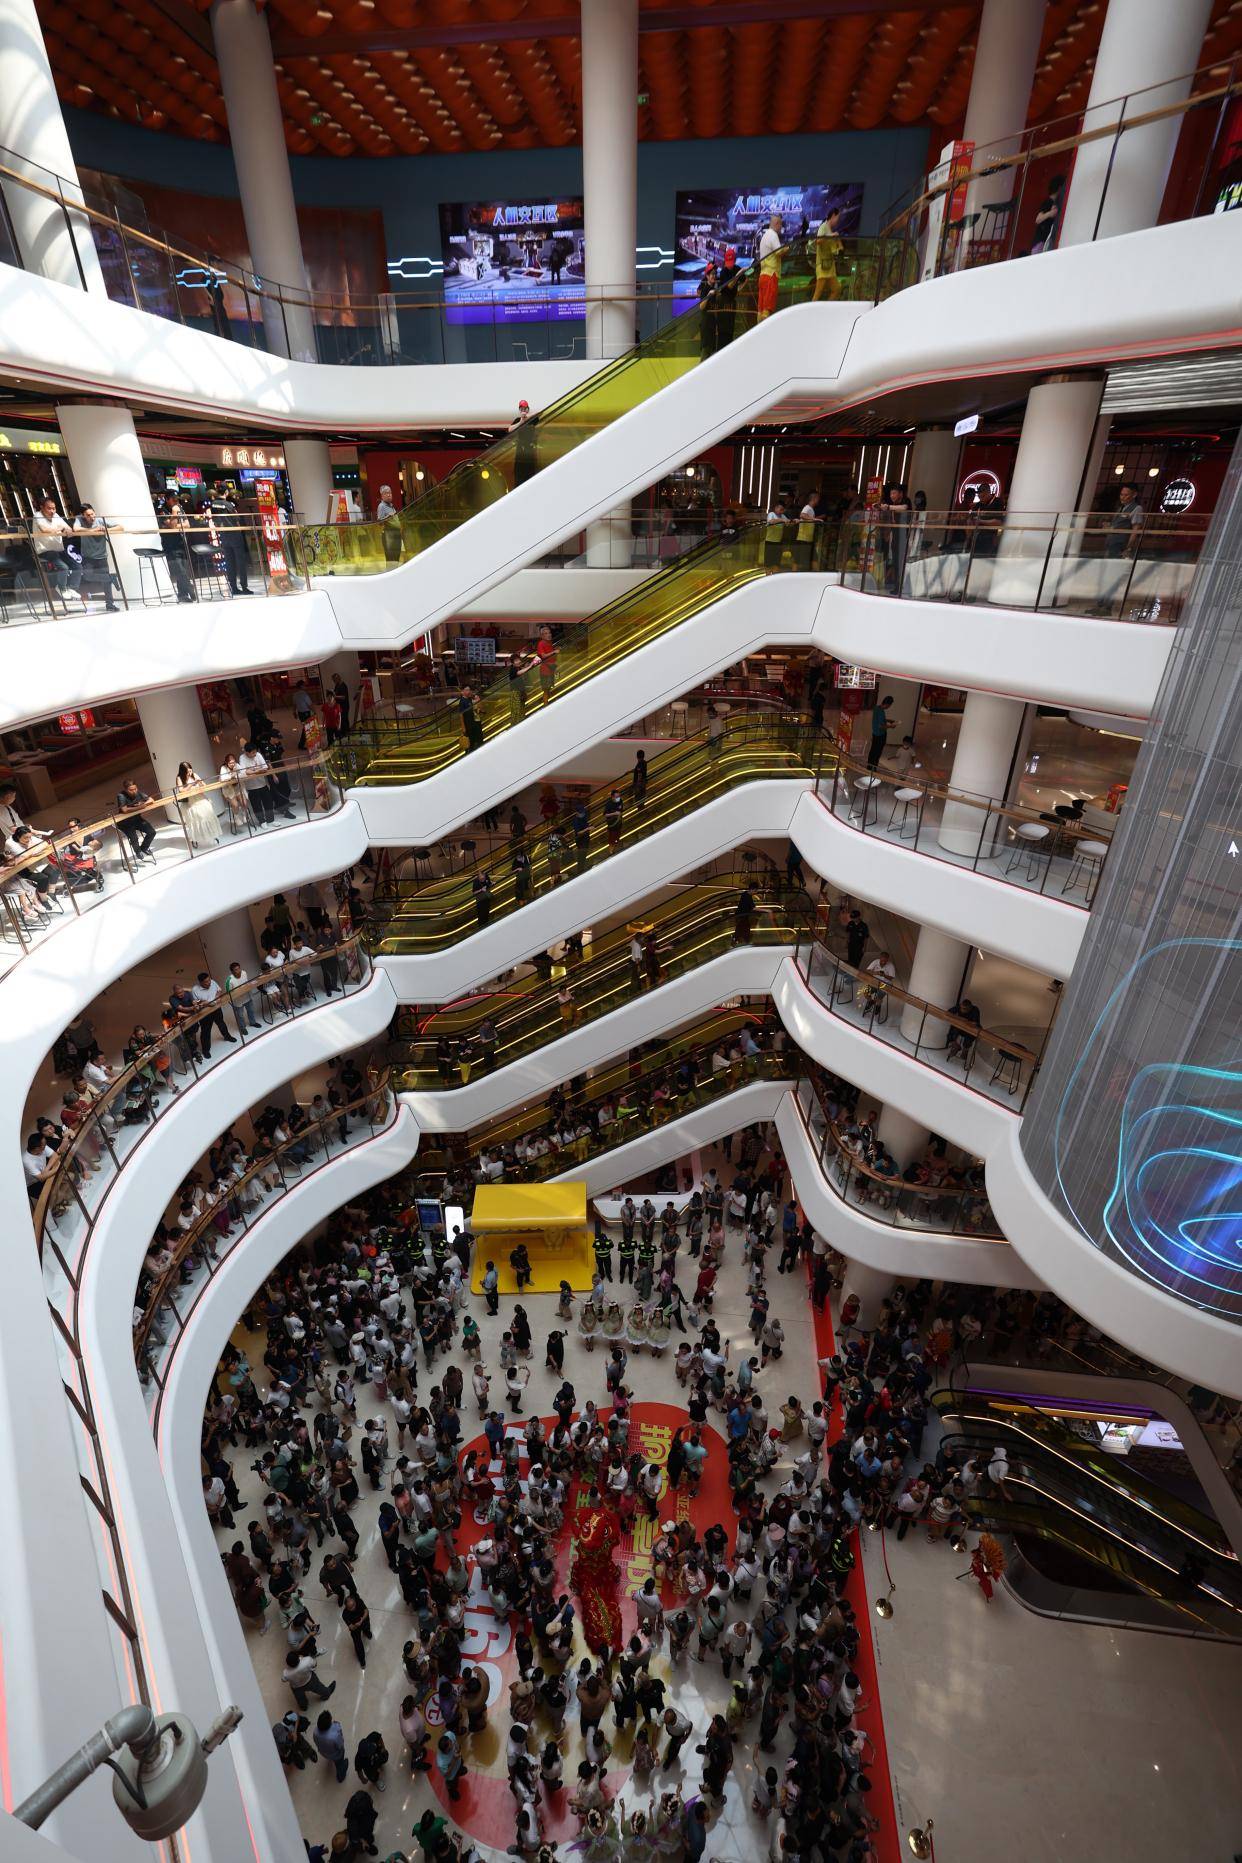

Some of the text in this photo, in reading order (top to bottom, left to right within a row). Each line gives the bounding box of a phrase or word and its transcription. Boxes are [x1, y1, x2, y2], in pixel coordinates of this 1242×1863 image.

[493, 205, 558, 226] 人机交互区
